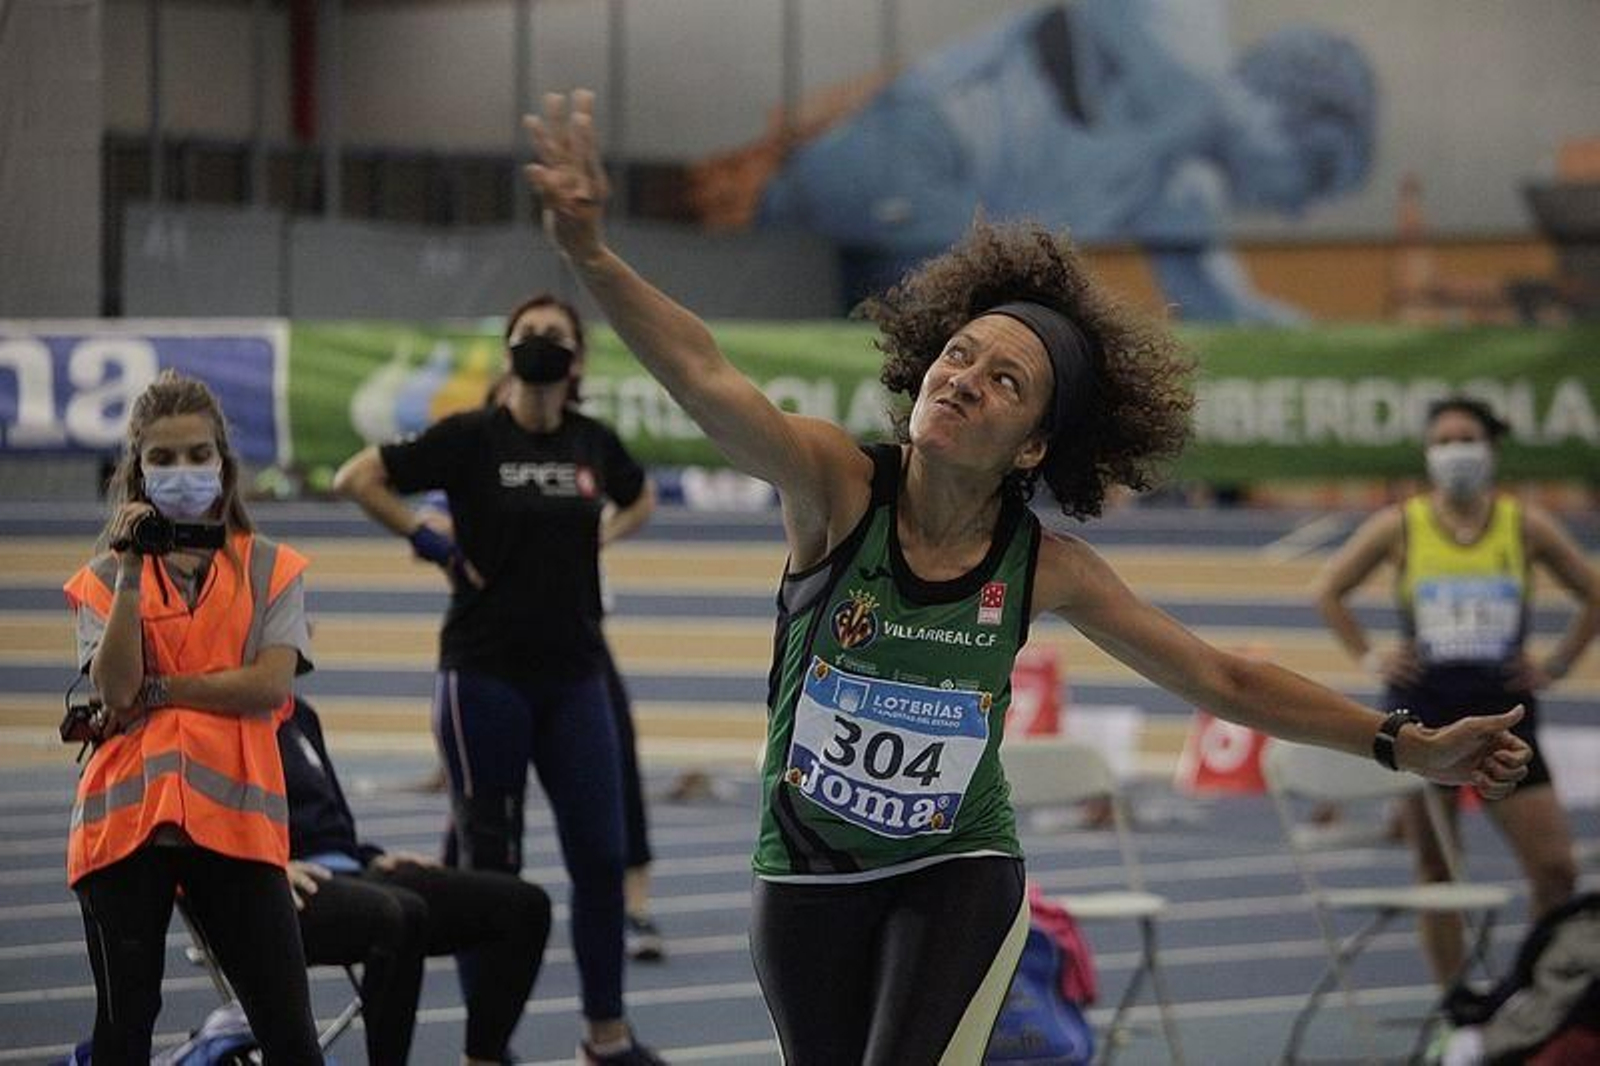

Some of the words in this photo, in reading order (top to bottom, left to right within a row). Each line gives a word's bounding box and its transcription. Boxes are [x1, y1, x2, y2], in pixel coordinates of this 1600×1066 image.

[884, 620, 972, 646] VILLARREAL
[873, 694, 964, 719] LOTERÍAS
[822, 714, 946, 787] 304
